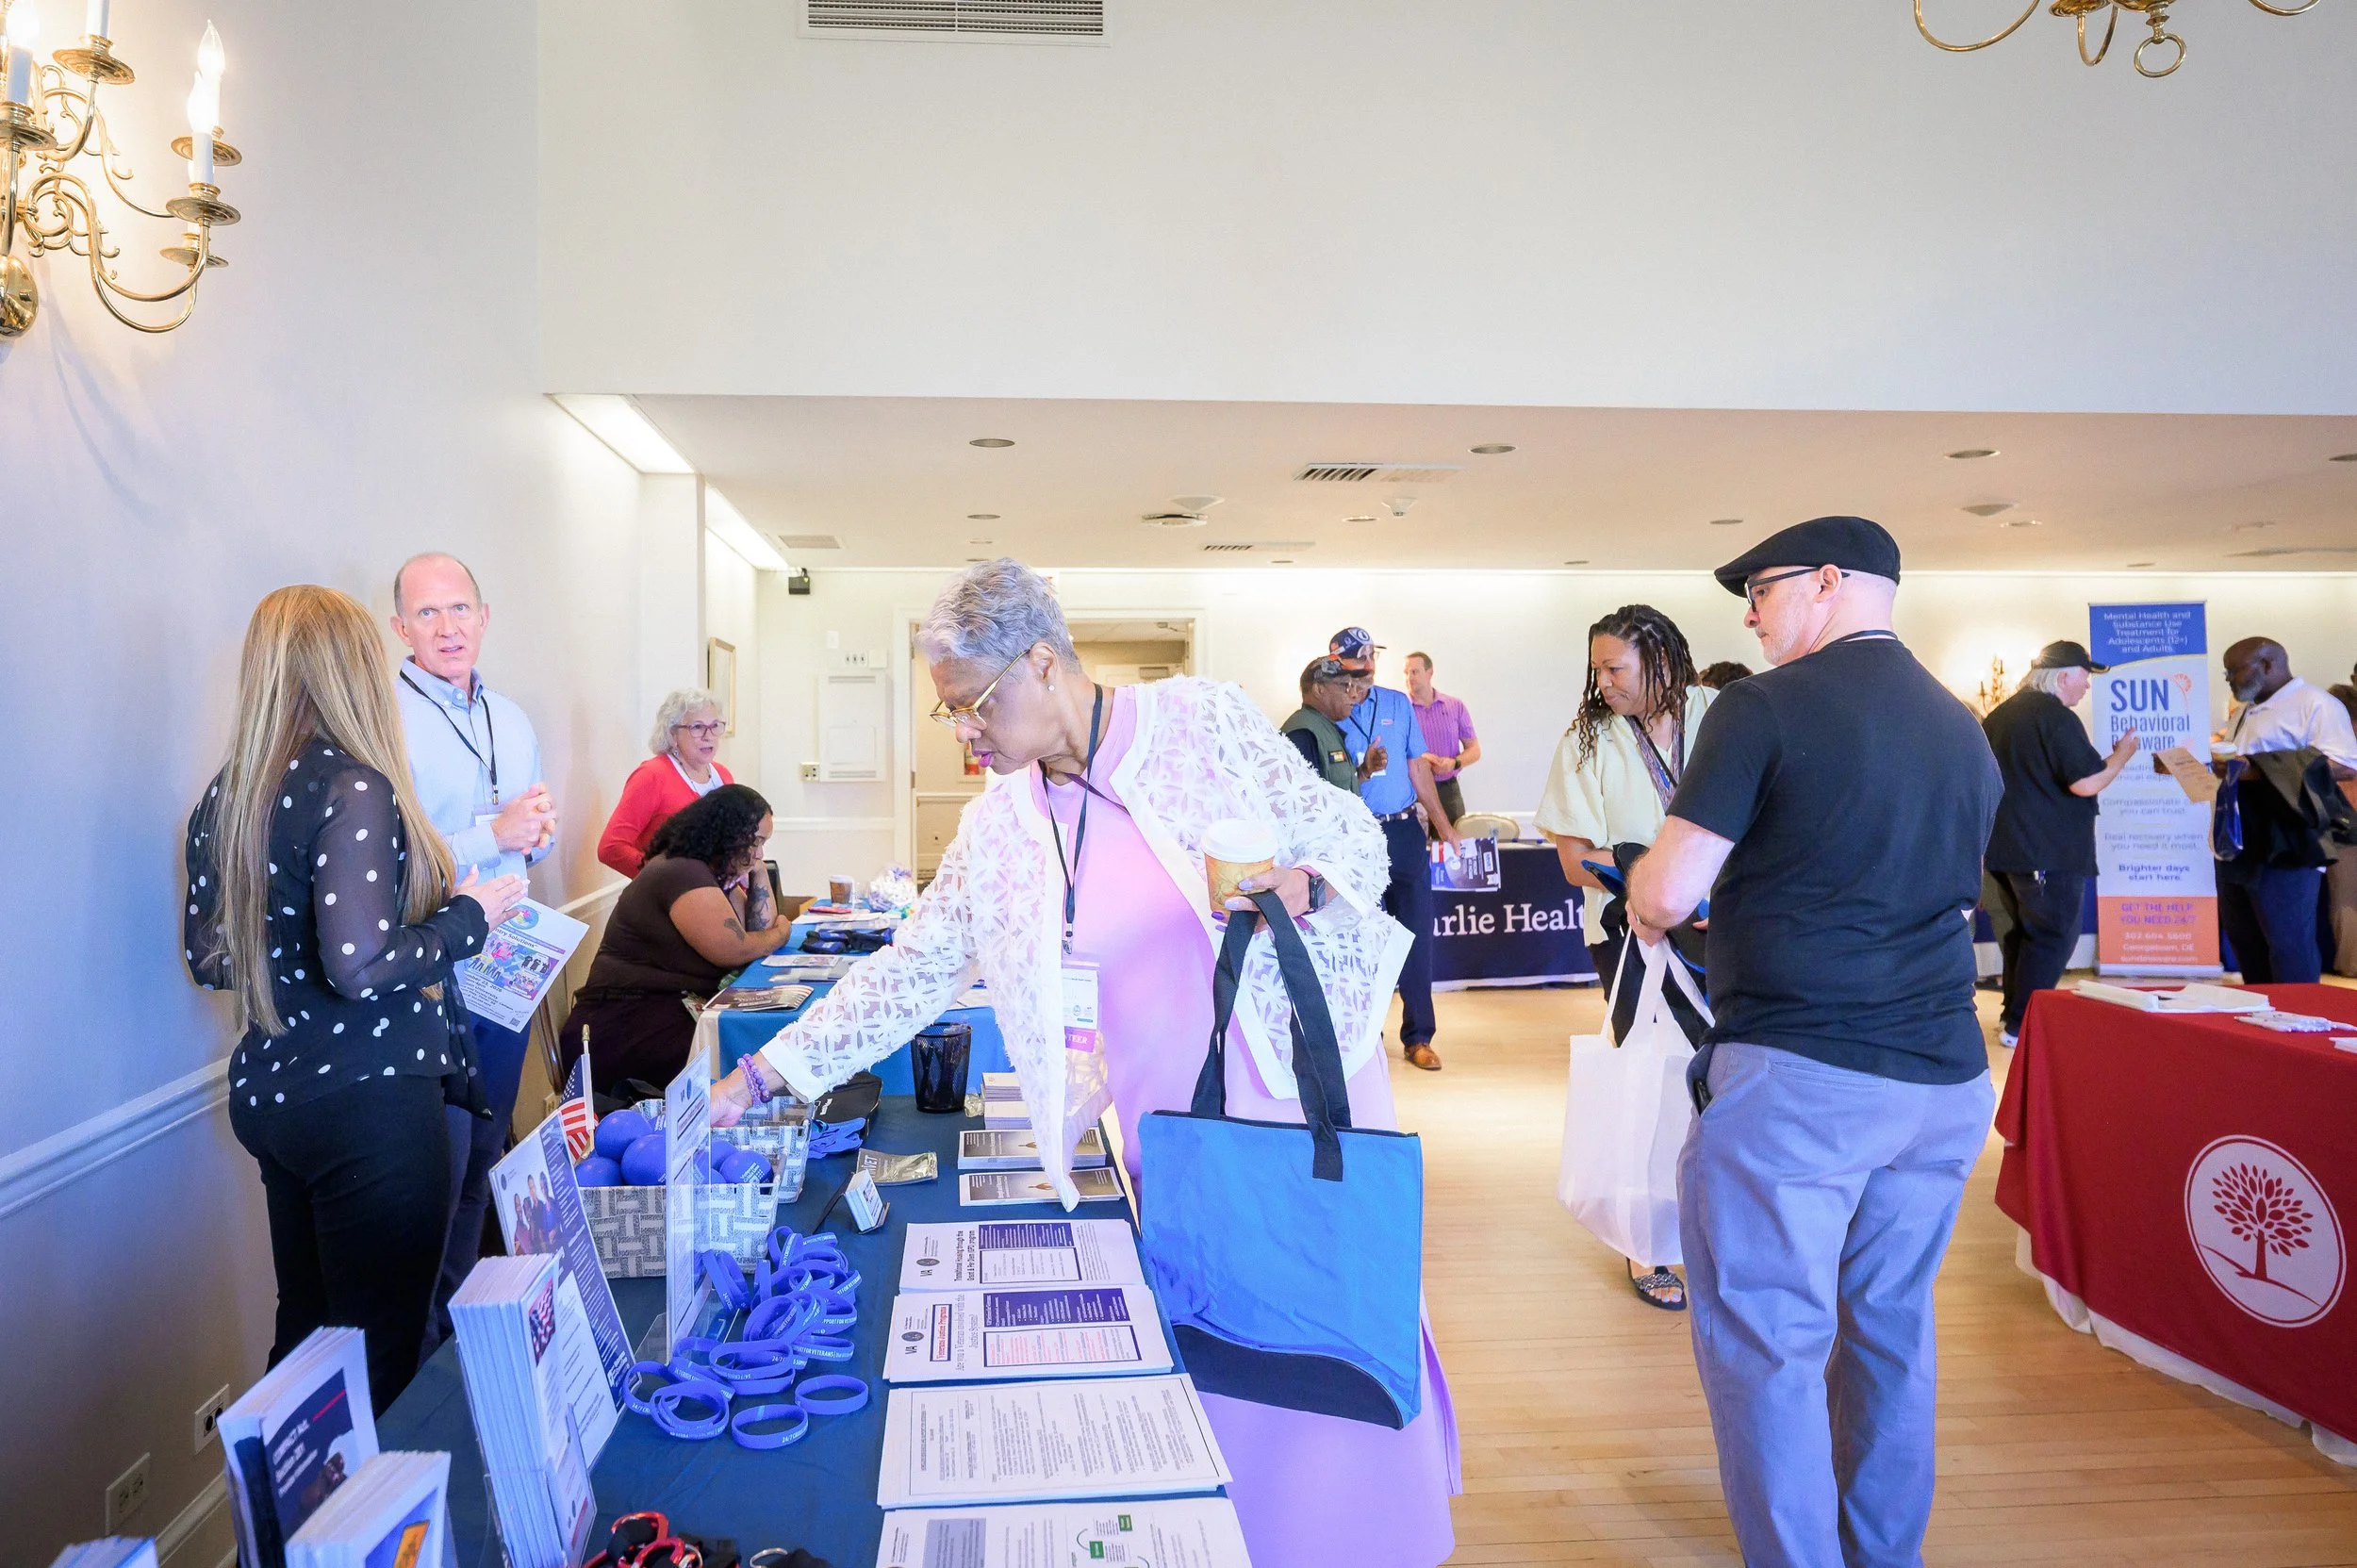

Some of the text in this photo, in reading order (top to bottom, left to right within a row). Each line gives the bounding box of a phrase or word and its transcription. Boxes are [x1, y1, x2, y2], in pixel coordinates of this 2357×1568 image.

[2103, 611, 2191, 620] Mental Health and
[2113, 620, 2162, 628] Substance
[2167, 628, 2179, 636] for
[2108, 636, 2165, 645] Adolescents
[2122, 645, 2140, 653] and
[2110, 679, 2169, 712] SUN
[2111, 714, 2190, 733] Behavioral
[2112, 734, 2175, 751] Dware
[2119, 864, 2190, 873] Brighter days
[920, 1269, 932, 1277] VA
[905, 1345, 917, 1355] VA
[936, 1340, 945, 1359] Veterans
